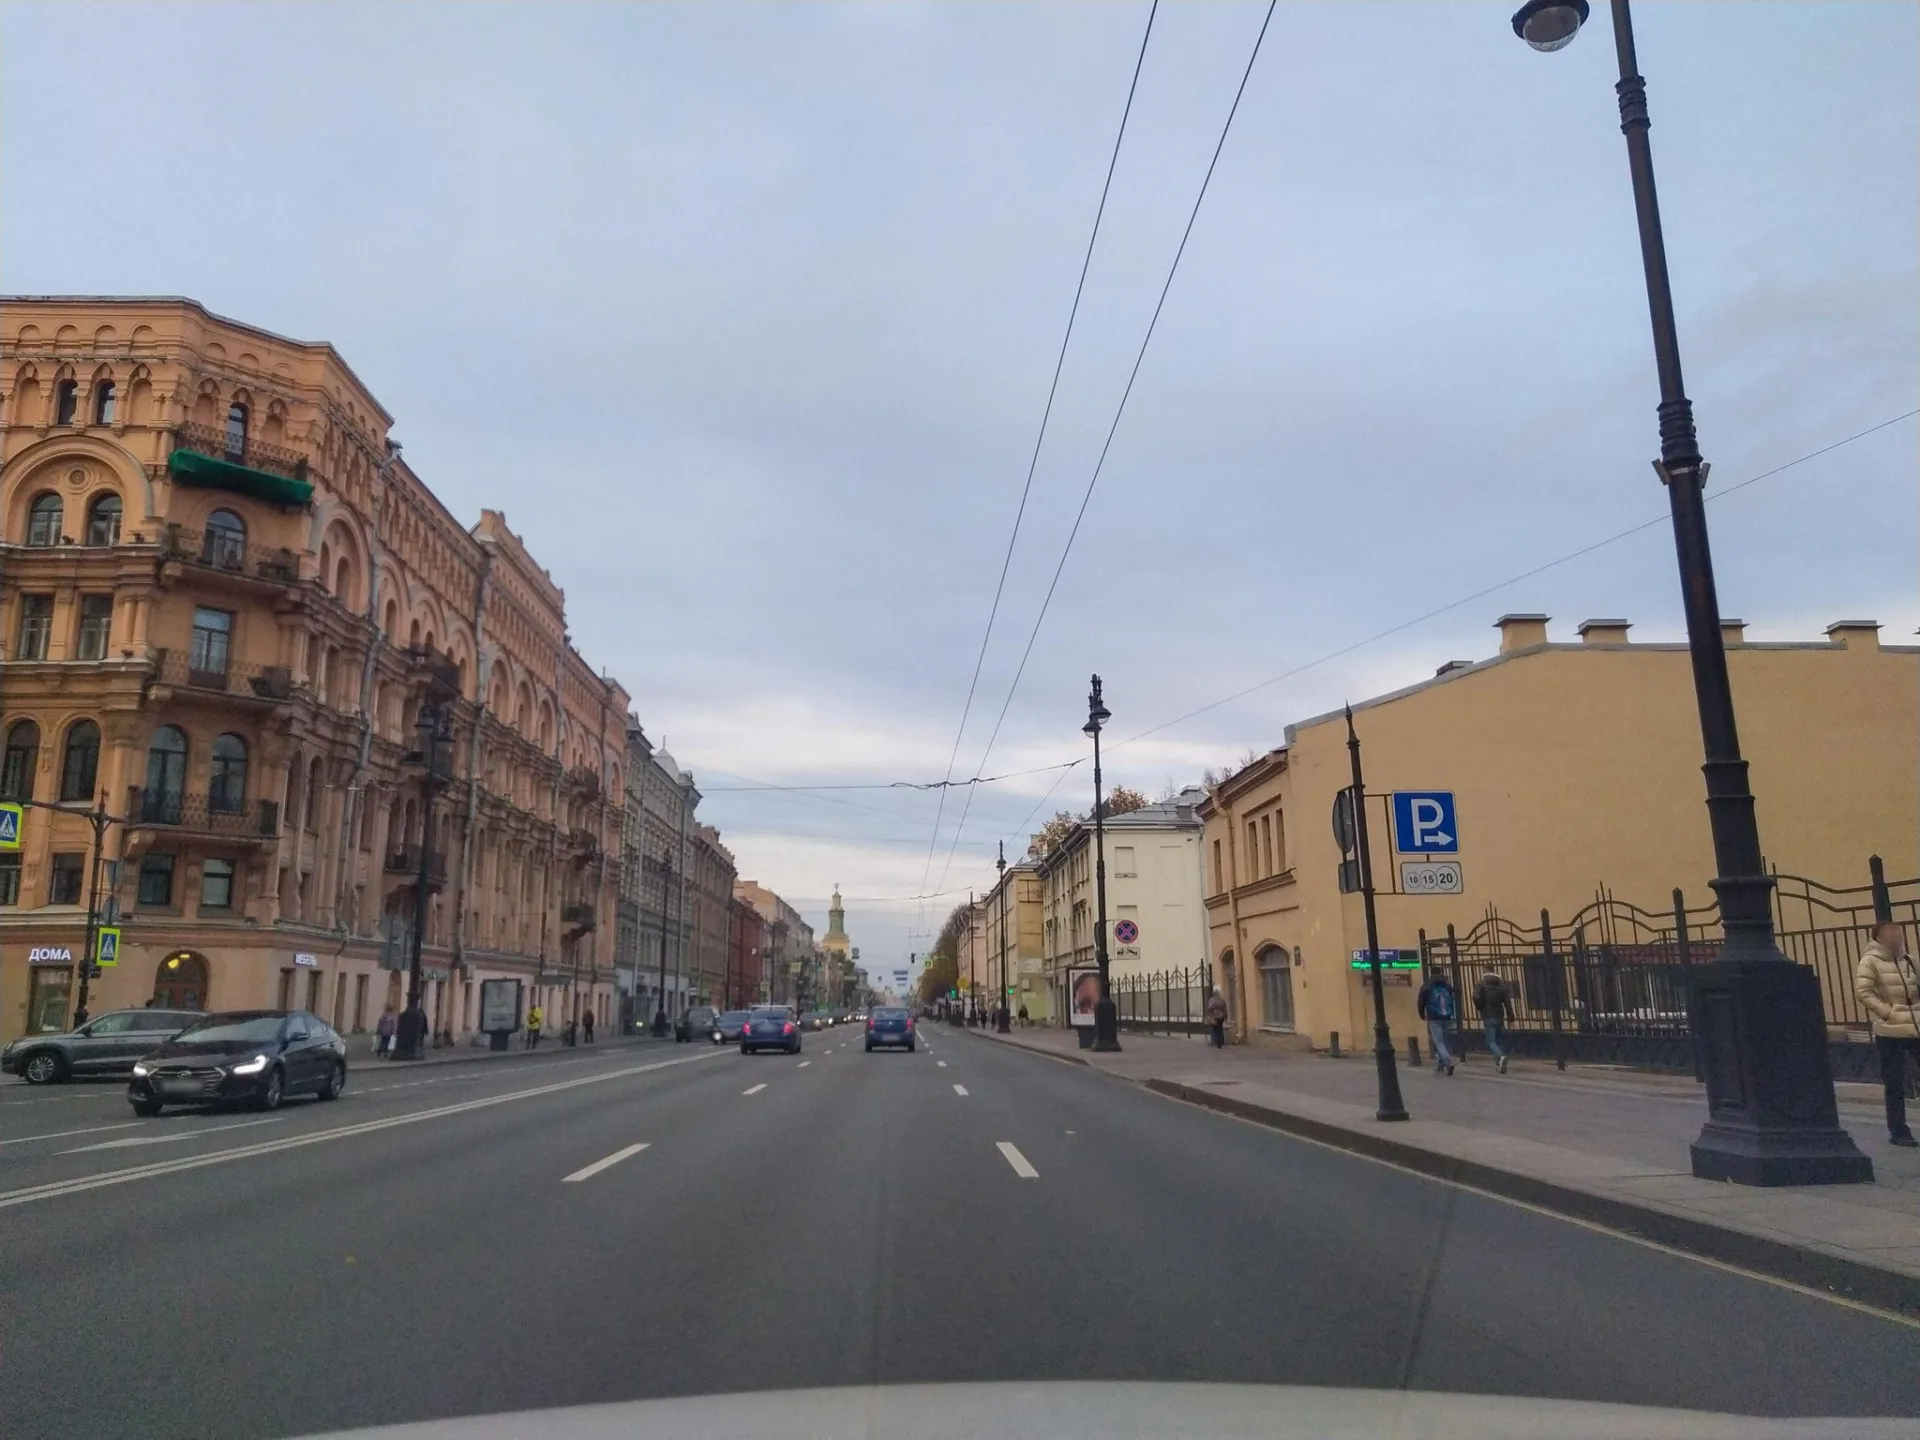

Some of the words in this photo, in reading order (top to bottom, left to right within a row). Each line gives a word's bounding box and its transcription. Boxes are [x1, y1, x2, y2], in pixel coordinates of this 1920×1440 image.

[1411, 799, 1444, 847] P
[1409, 876, 1419, 884] 10
[1423, 875, 1434, 884] 15
[1439, 873, 1453, 884] 20
[28, 948, 71, 962] ДОМА
